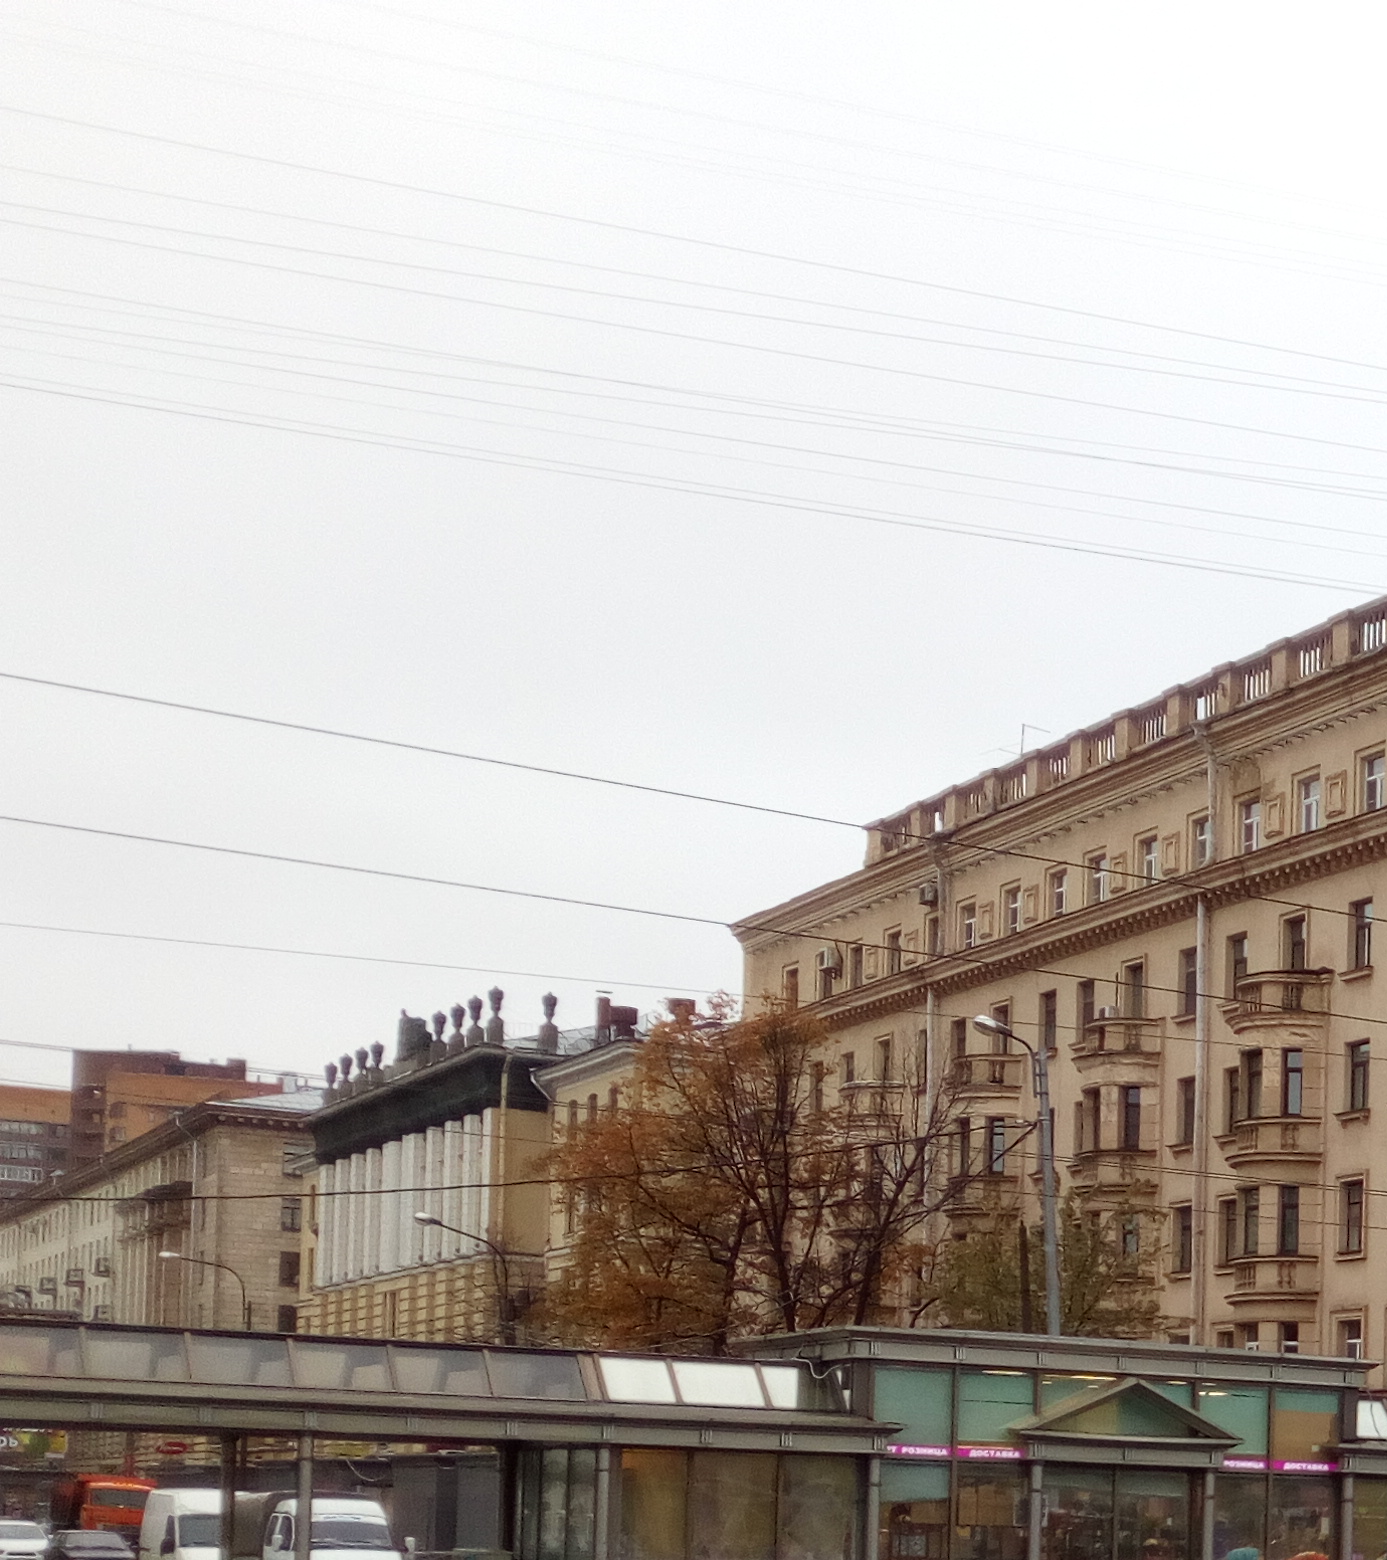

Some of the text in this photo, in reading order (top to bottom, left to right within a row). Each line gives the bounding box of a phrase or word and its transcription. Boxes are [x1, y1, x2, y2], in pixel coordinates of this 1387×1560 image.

[902, 1446, 948, 1456] РОЗНИЦА
[969, 1449, 1021, 1459] ДОСТАВКА
[1283, 1462, 1330, 1471] ДОСТАВКА
